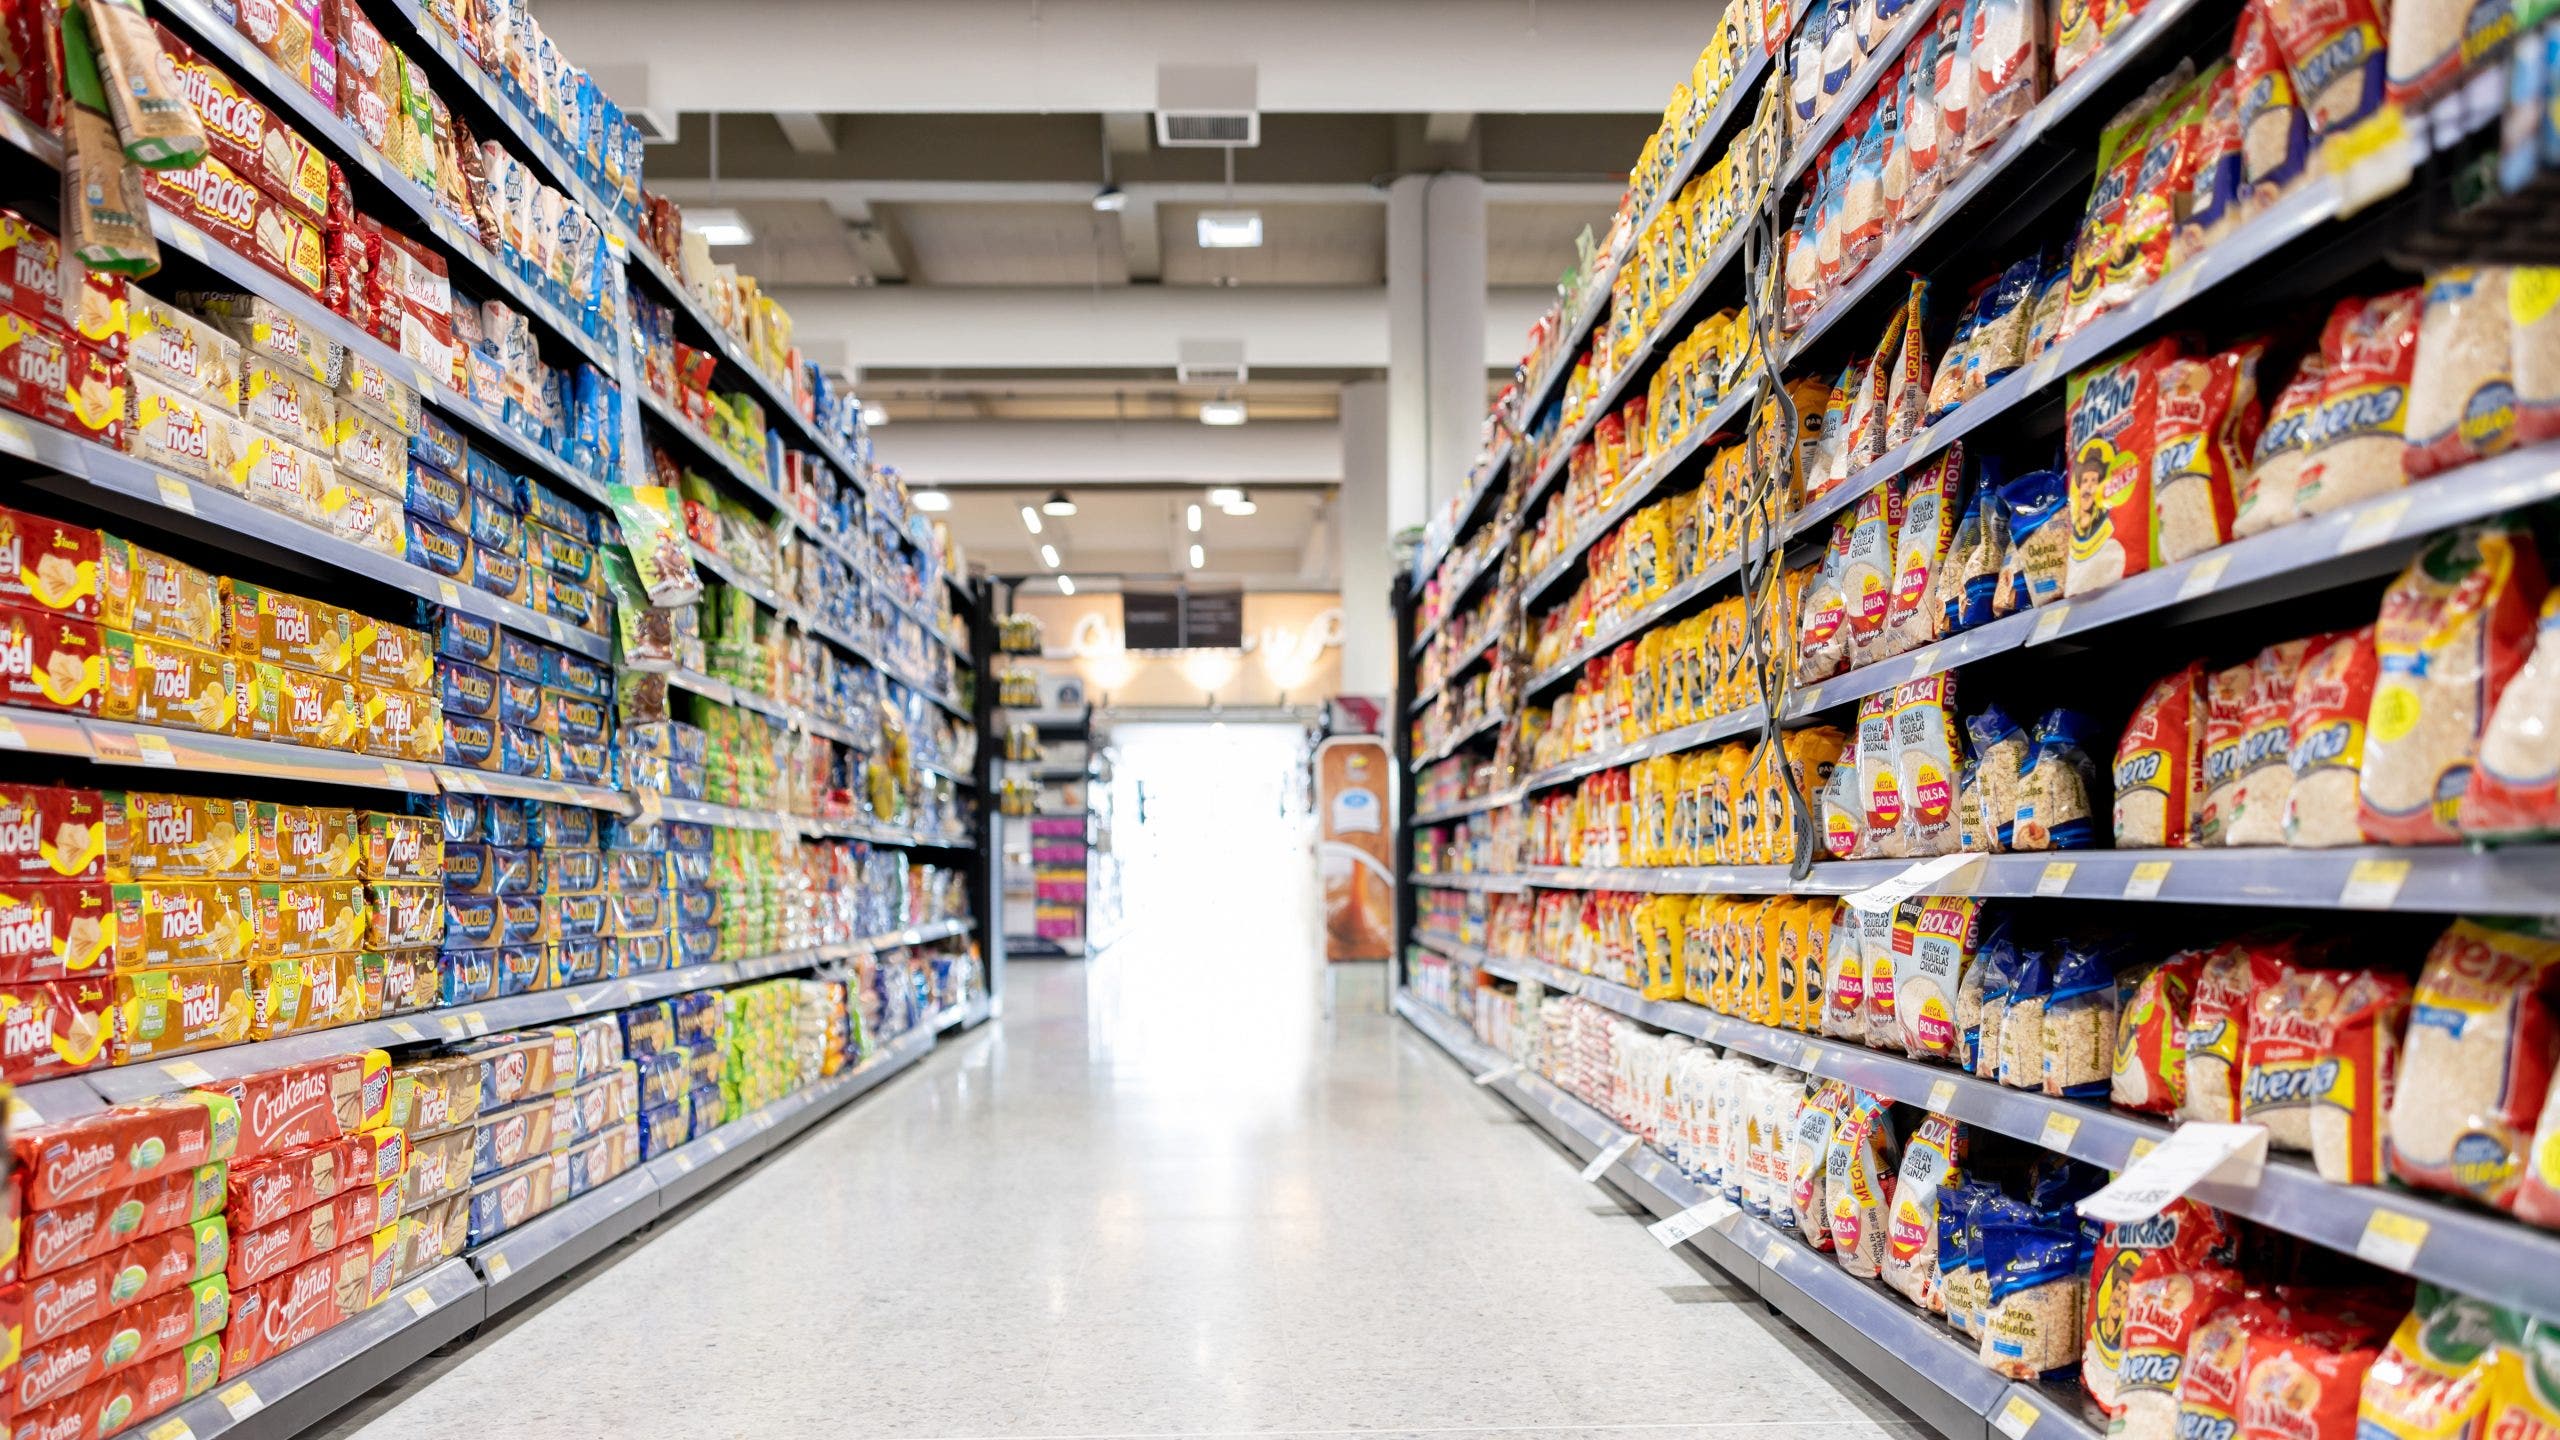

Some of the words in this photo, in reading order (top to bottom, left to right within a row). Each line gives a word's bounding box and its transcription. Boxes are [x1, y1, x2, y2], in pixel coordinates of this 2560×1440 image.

[269, 329, 299, 355] noel
[1907, 330, 1920, 379] GRATIS
[18, 351, 67, 394] noel
[159, 340, 198, 377] noel
[362, 377, 385, 403] noel
[2311, 386, 2404, 442] vena
[166, 425, 208, 459] noel
[271, 463, 302, 495] noel
[1945, 440, 1963, 494] BOLSA
[349, 507, 377, 535] noel
[1939, 505, 1953, 555] MEGA
[426, 530, 460, 560] DUCALES
[146, 573, 181, 606] noel
[1901, 573, 1923, 588] BOLSA
[1815, 612, 1838, 623] BOLSA
[1863, 596, 1885, 611] BOLSA
[275, 613, 310, 645] noel
[376, 636, 404, 663] noel
[153, 665, 191, 699] noel
[459, 674, 491, 698] DUCALES
[1900, 713, 1915, 725] AVENA
[1915, 711, 1924, 720] EN
[1900, 722, 1925, 735] HOJUELAS
[454, 726, 489, 746] DUCALES
[1948, 717, 1964, 765] MEGA
[1877, 780, 1893, 789] MEGA
[1919, 773, 1937, 783] MEGA
[2115, 750, 2162, 791] vena
[1875, 794, 1900, 808] BOLSA
[1918, 786, 1948, 803] BOLSA
[147, 811, 193, 846] noel
[292, 824, 323, 857] noel
[445, 855, 479, 873] DUCALES
[162, 899, 204, 939] noel
[297, 896, 325, 934] noel
[1900, 902, 1923, 917] QUAKER
[1918, 910, 1965, 938] BOLSA
[0, 909, 53, 954] noel
[1921, 952, 1950, 967] HOJUELAS
[1922, 940, 1940, 953] AVENA
[1941, 946, 1951, 956] EN
[1875, 967, 1891, 976] MEGA
[1919, 962, 1947, 977] ORIGINAL
[1838, 980, 1862, 993] BOLSA
[1873, 982, 1893, 994] BOLS
[183, 985, 220, 1029] noel
[1925, 1005, 1942, 1018] MEGA
[5, 1006, 57, 1056] noel
[1918, 1019, 1949, 1036] BOLSA
[252, 1071, 327, 1137] Crakeñas
[419, 1086, 450, 1129] noel
[47, 1141, 115, 1196] Crakeñas
[419, 1155, 447, 1197] noel
[254, 1170, 292, 1218] Crakeñas
[34, 1206, 95, 1266] Crakeñas
[243, 1226, 290, 1274] Crakeñas
[415, 1222, 444, 1264] noel
[34, 1274, 97, 1336] Crakeñas
[263, 1261, 331, 1344] Crakeñas
[20, 1342, 92, 1408] Crakeñas
